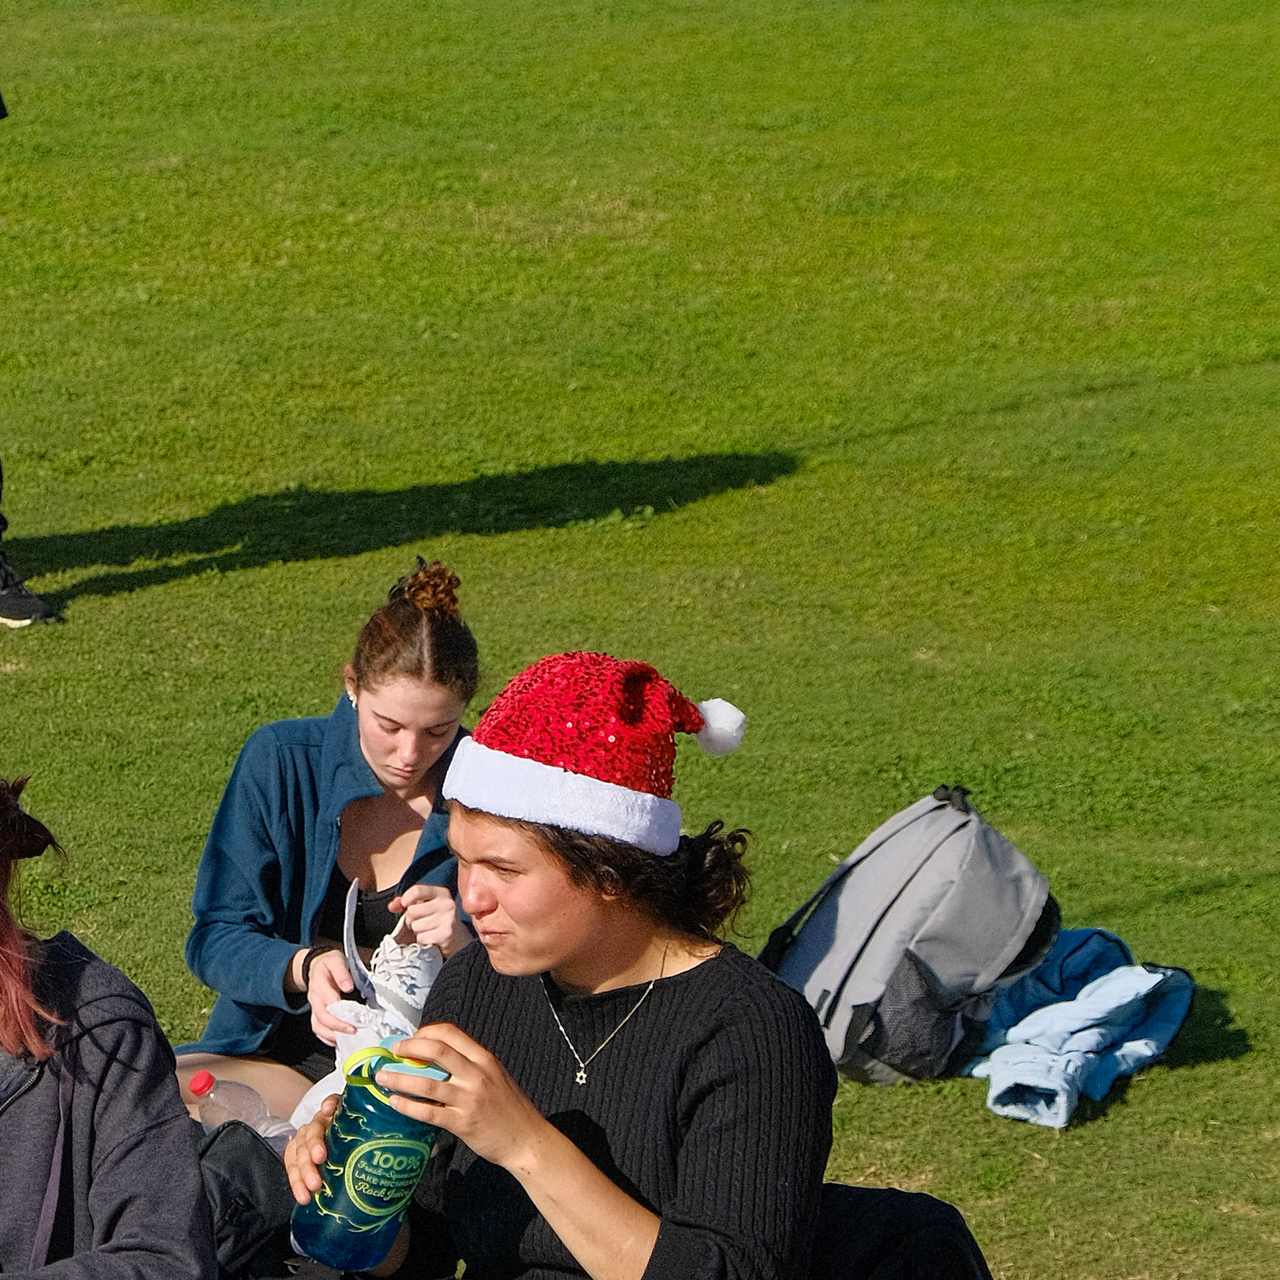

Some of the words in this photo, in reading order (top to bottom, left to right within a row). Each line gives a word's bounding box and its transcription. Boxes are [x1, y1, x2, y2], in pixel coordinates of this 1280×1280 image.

[372, 1149, 421, 1171] 100%
[355, 1171, 379, 1185] LAKE
[355, 1181, 386, 1198] Rock
